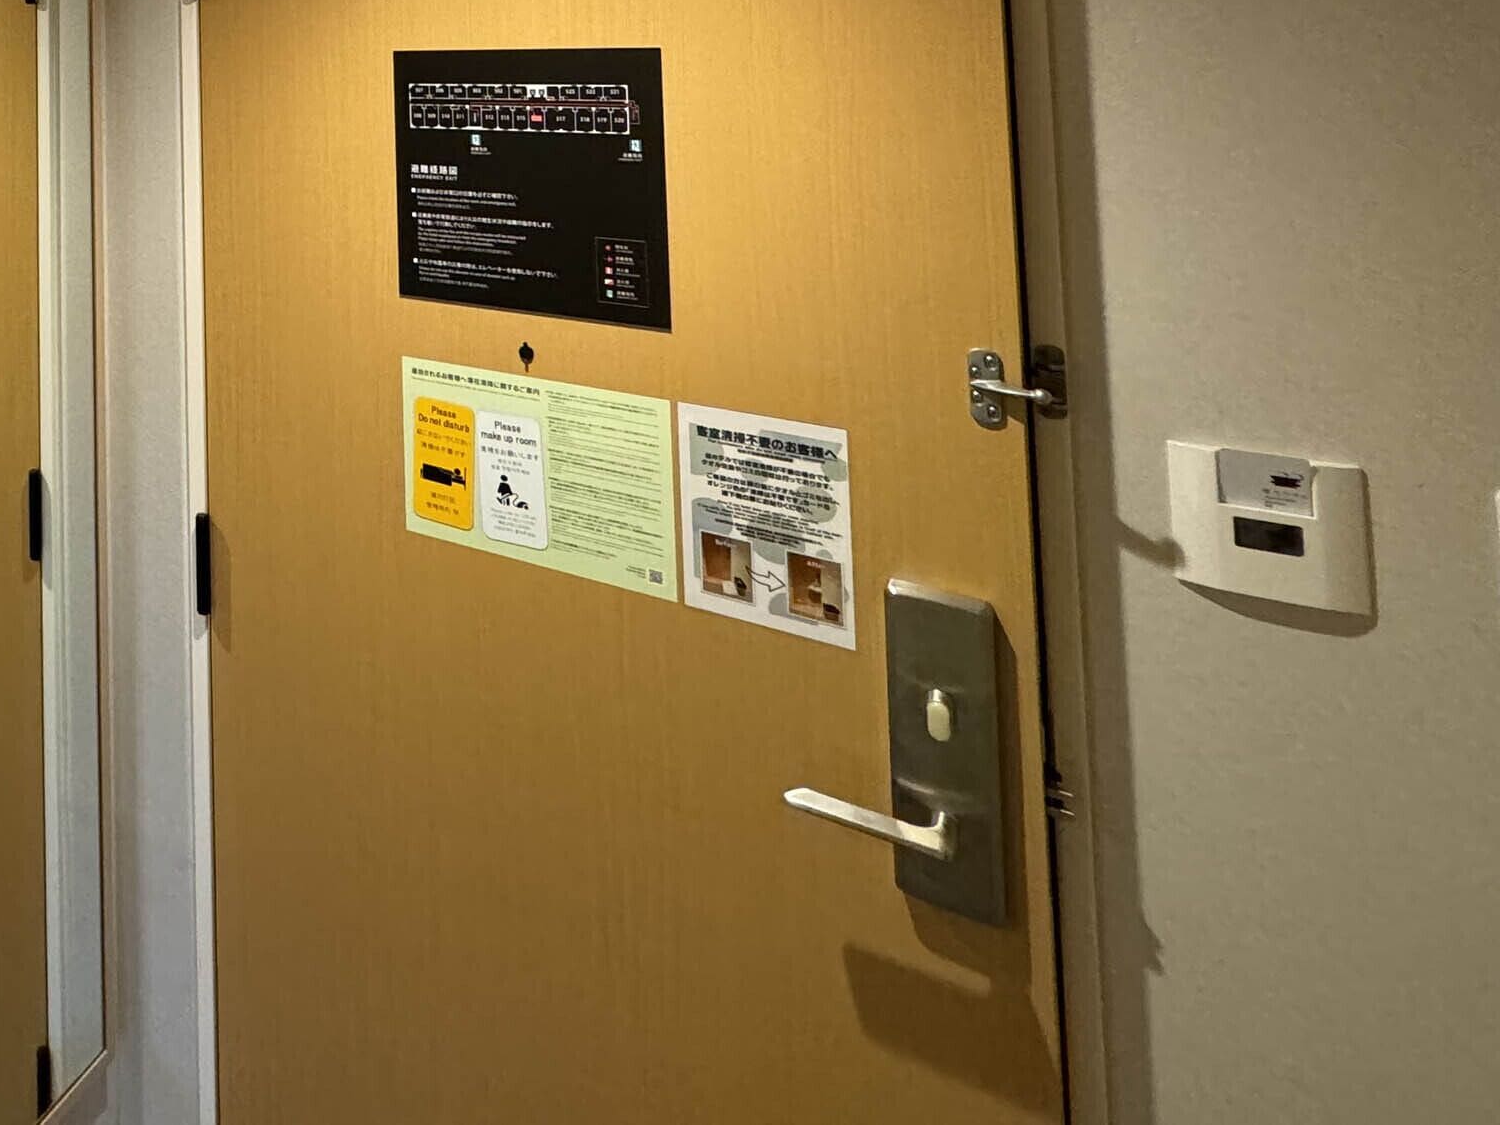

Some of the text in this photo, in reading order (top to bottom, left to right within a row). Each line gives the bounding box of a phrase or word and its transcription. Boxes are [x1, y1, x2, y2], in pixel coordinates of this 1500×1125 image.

[431, 405, 457, 419] Please
[418, 413, 470, 433] Do not disturb
[494, 420, 521, 433] Please
[481, 431, 537, 447] make up room
[696, 425, 838, 459] 客室清掃不要のお客様へ
